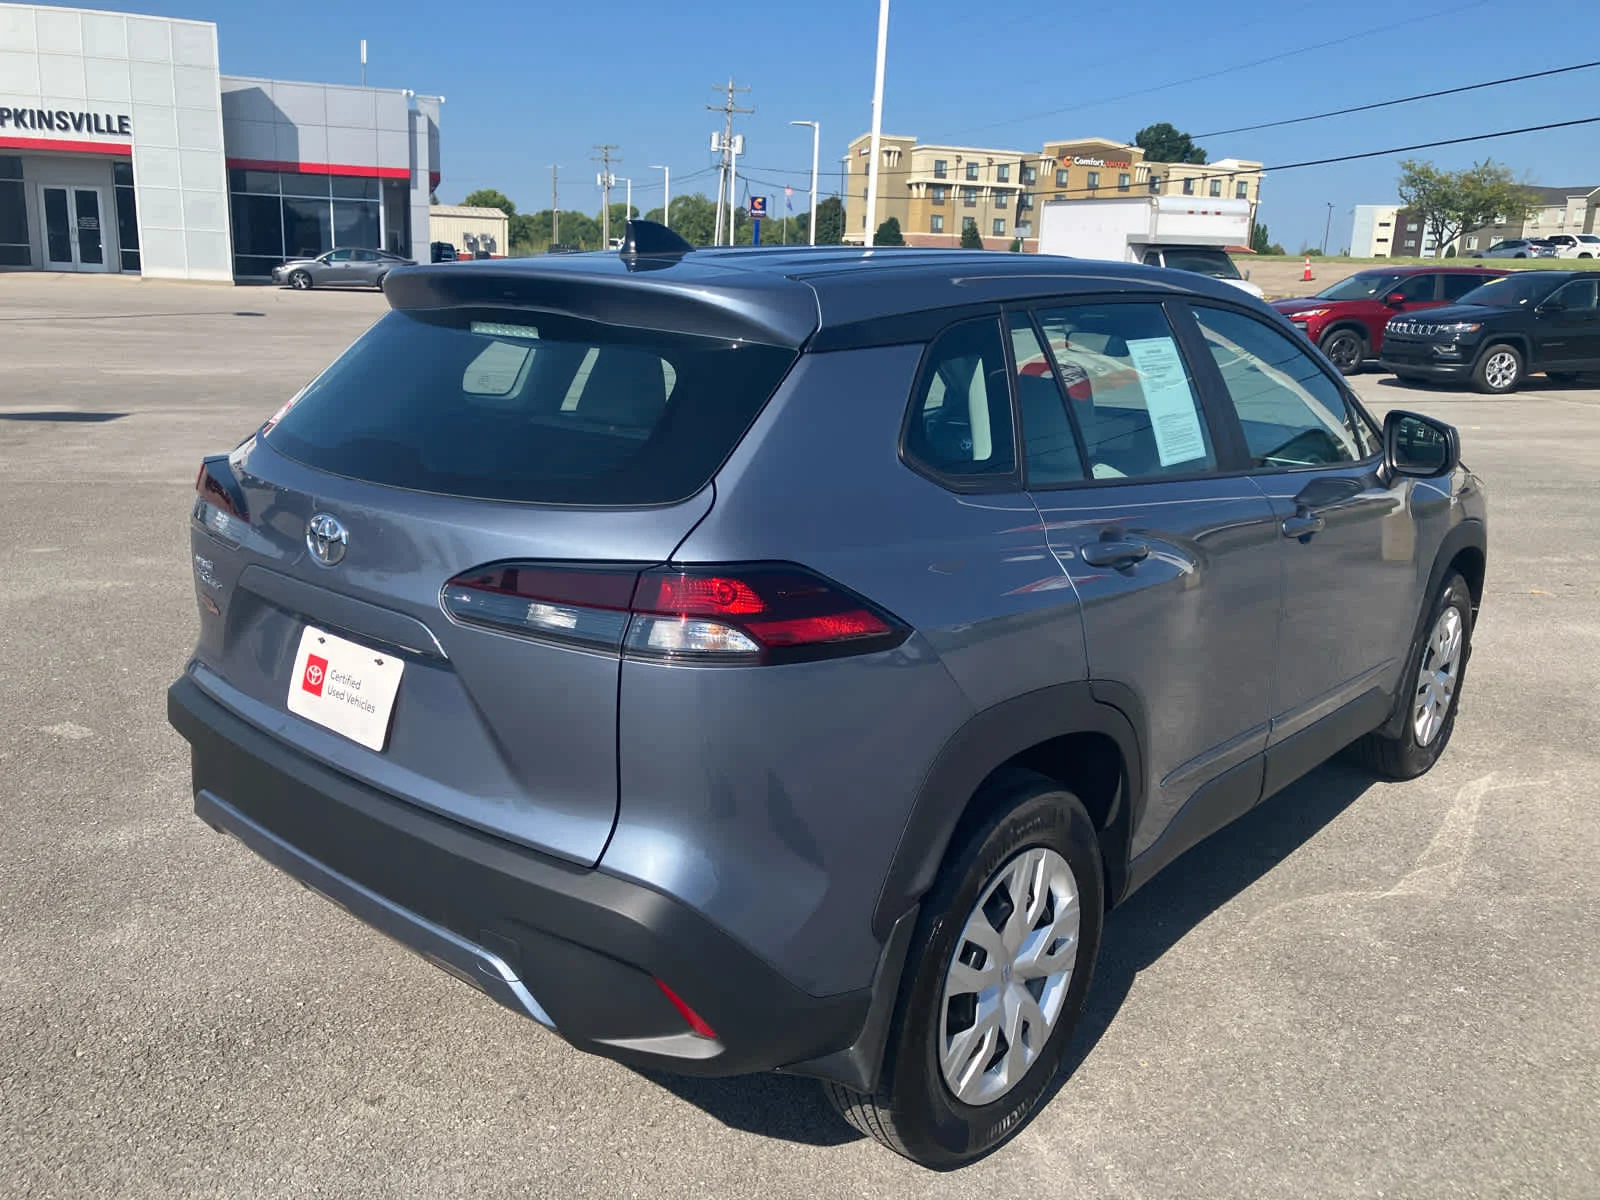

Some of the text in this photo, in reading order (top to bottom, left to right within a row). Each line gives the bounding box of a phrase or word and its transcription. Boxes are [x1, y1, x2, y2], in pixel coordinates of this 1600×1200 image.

[0, 107, 131, 136] PKINSVILLE
[1074, 156, 1105, 166] Comfort
[330, 669, 361, 690] Certified
[327, 685, 375, 714] Used Vehicles
